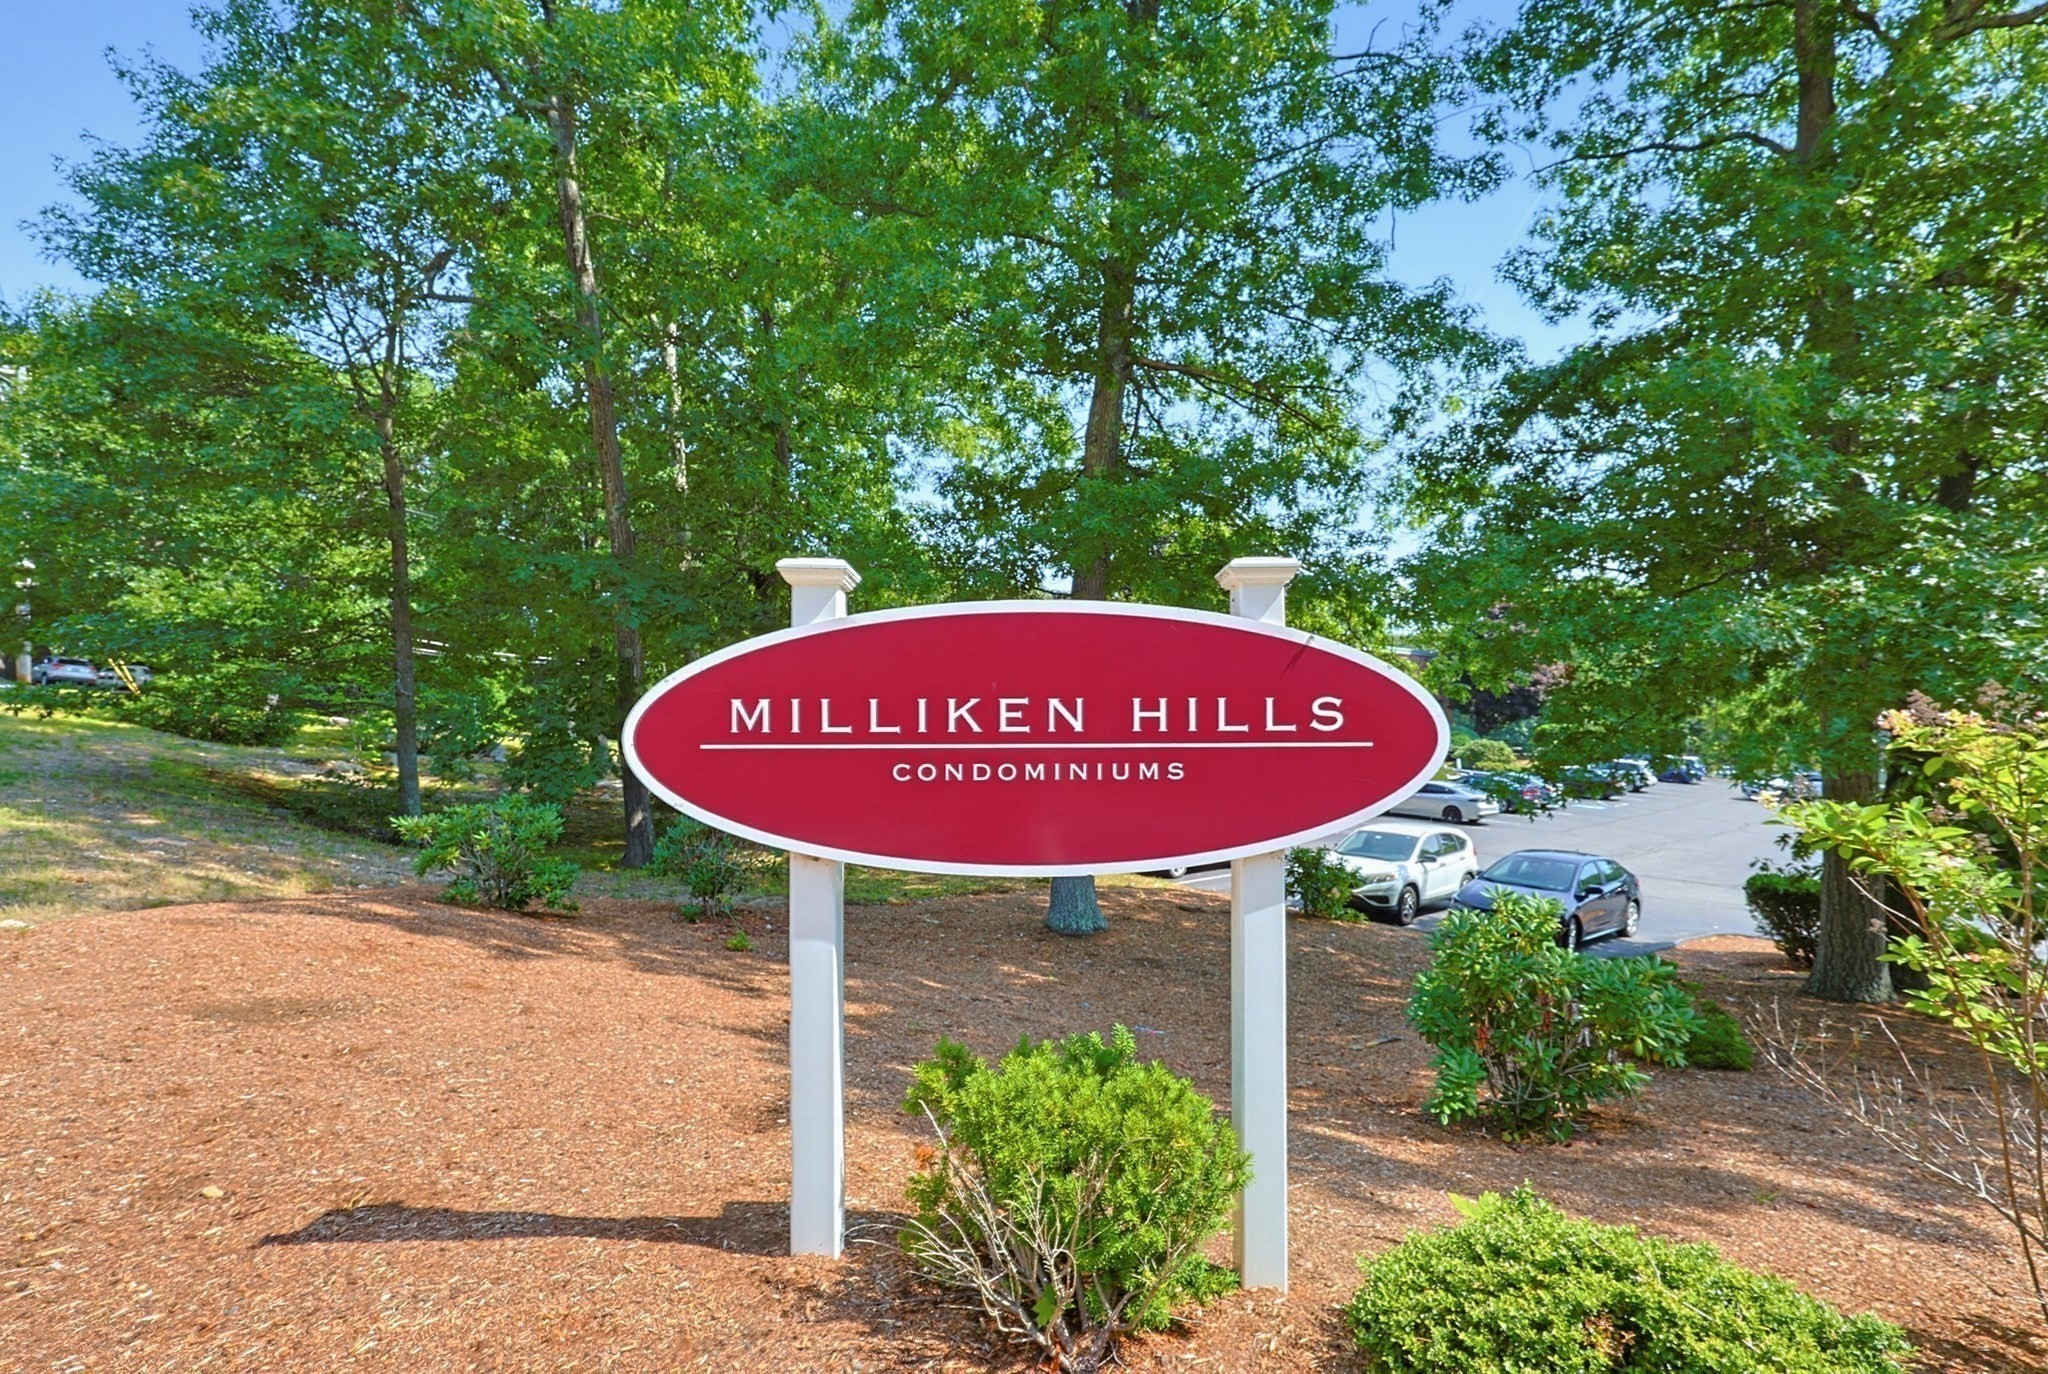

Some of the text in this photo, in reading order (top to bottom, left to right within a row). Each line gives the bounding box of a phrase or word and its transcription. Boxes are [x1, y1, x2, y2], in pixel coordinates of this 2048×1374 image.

[730, 695, 1345, 734] MILLIKEN HILLS
[891, 761, 1186, 782] CONDOMINIUMS
